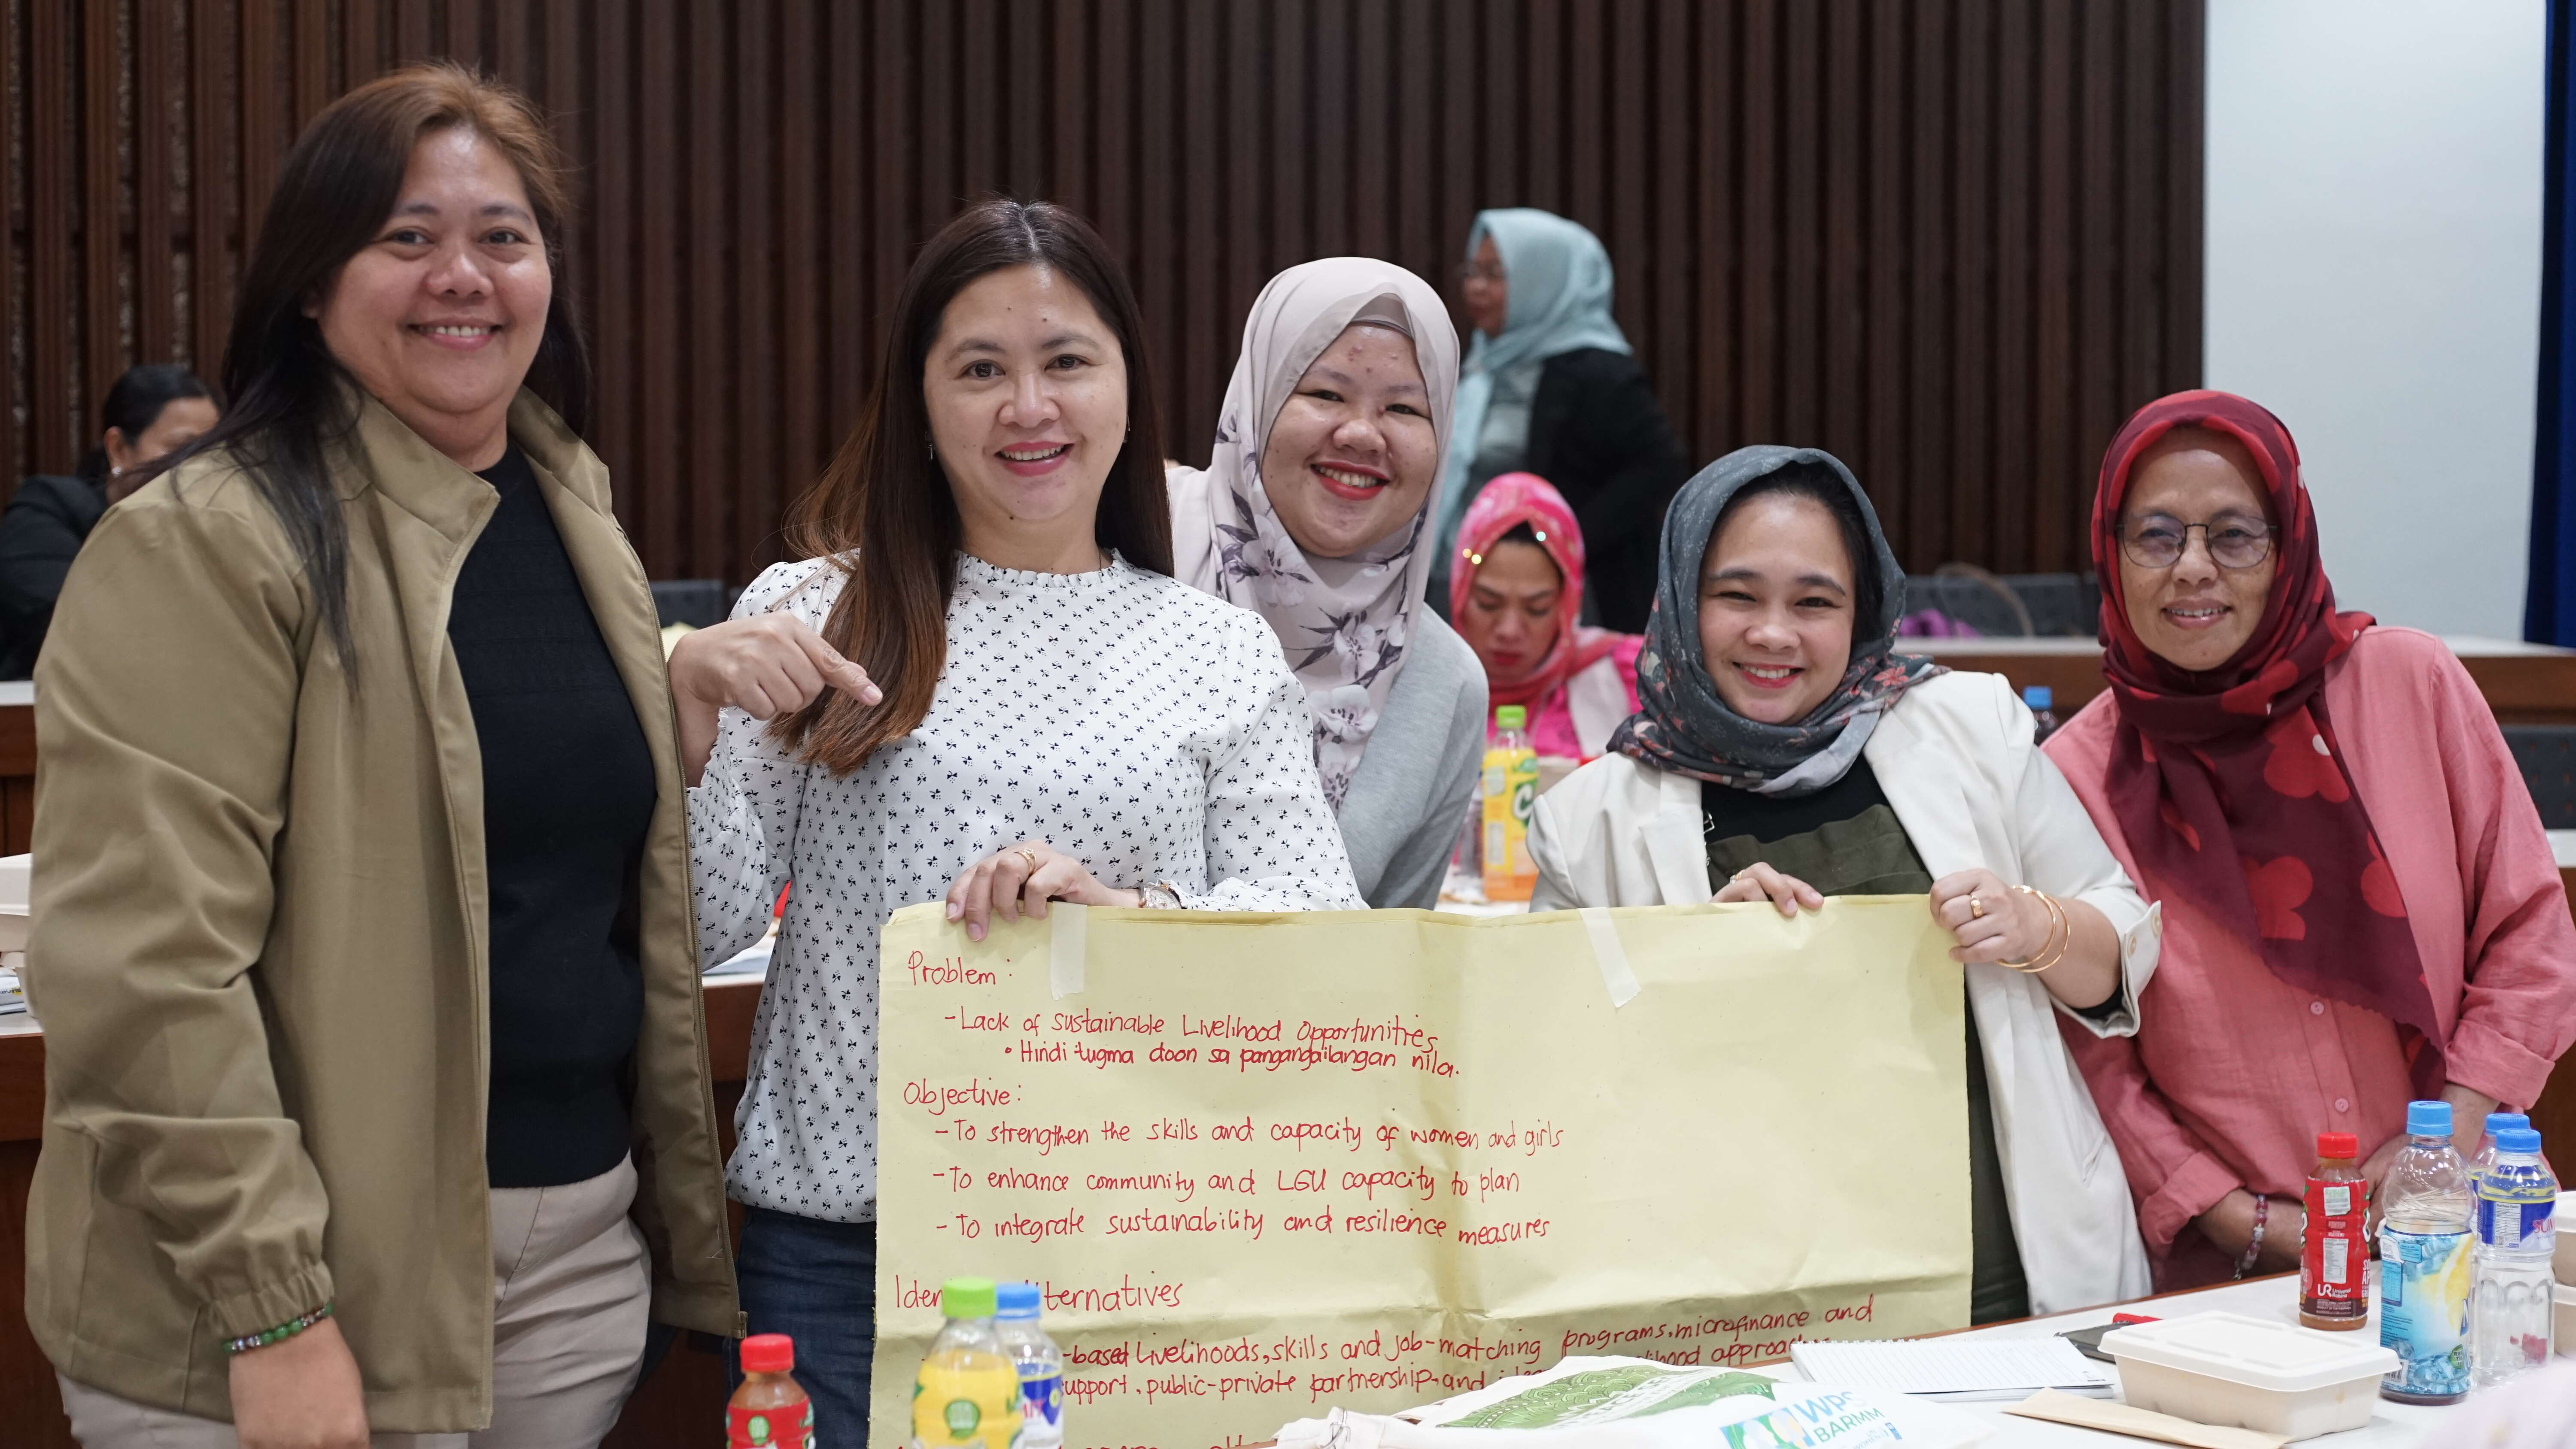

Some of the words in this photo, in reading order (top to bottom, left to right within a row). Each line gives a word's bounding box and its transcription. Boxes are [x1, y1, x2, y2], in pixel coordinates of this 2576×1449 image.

[1024, 1014, 1041, 1037] of
[1052, 1007, 1165, 1035] sustainable
[1183, 1014, 1282, 1042] Livelihood
[1021, 1040, 1067, 1063] Hindi
[1075, 1042, 1134, 1069] tugma
[1149, 1042, 1197, 1063] doon
[1208, 1049, 1230, 1064] sa
[1239, 1044, 1396, 1073] pangangailangan
[988, 1122, 1089, 1155] strengthen
[1101, 1121, 1130, 1142] the
[1147, 1119, 1198, 1140] skills
[1212, 1116, 1254, 1142] and
[1271, 1117, 1361, 1152] capacity
[1376, 1125, 1400, 1151] of
[1410, 1129, 1479, 1150] women
[1488, 1120, 1516, 1148] and
[1525, 1119, 1564, 1156] girls
[987, 1168, 1069, 1192] enhance
[1087, 1171, 1195, 1201] community
[1208, 1170, 1255, 1195] and
[1278, 1168, 1327, 1192] LGU
[1342, 1165, 1434, 1201] capacity
[1451, 1170, 1468, 1197] to
[1480, 1167, 1519, 1203] plan
[995, 1207, 1084, 1243] integrate
[1106, 1207, 1264, 1240] sustainability
[1284, 1204, 1333, 1233] and
[1346, 1208, 1448, 1237] resilience
[1458, 1219, 1550, 1246] measures
[1025, 1271, 1183, 1312] ternatives
[2318, 1284, 2332, 1297] UR
[1341, 1329, 1381, 1360] and
[1385, 1329, 1540, 1365] job-matching
[1826, 1293, 1874, 1322] and
[1147, 1370, 1297, 1404] public-private
[1793, 1391, 1867, 1423] WPS
[1813, 1407, 1886, 1443] BARMM
